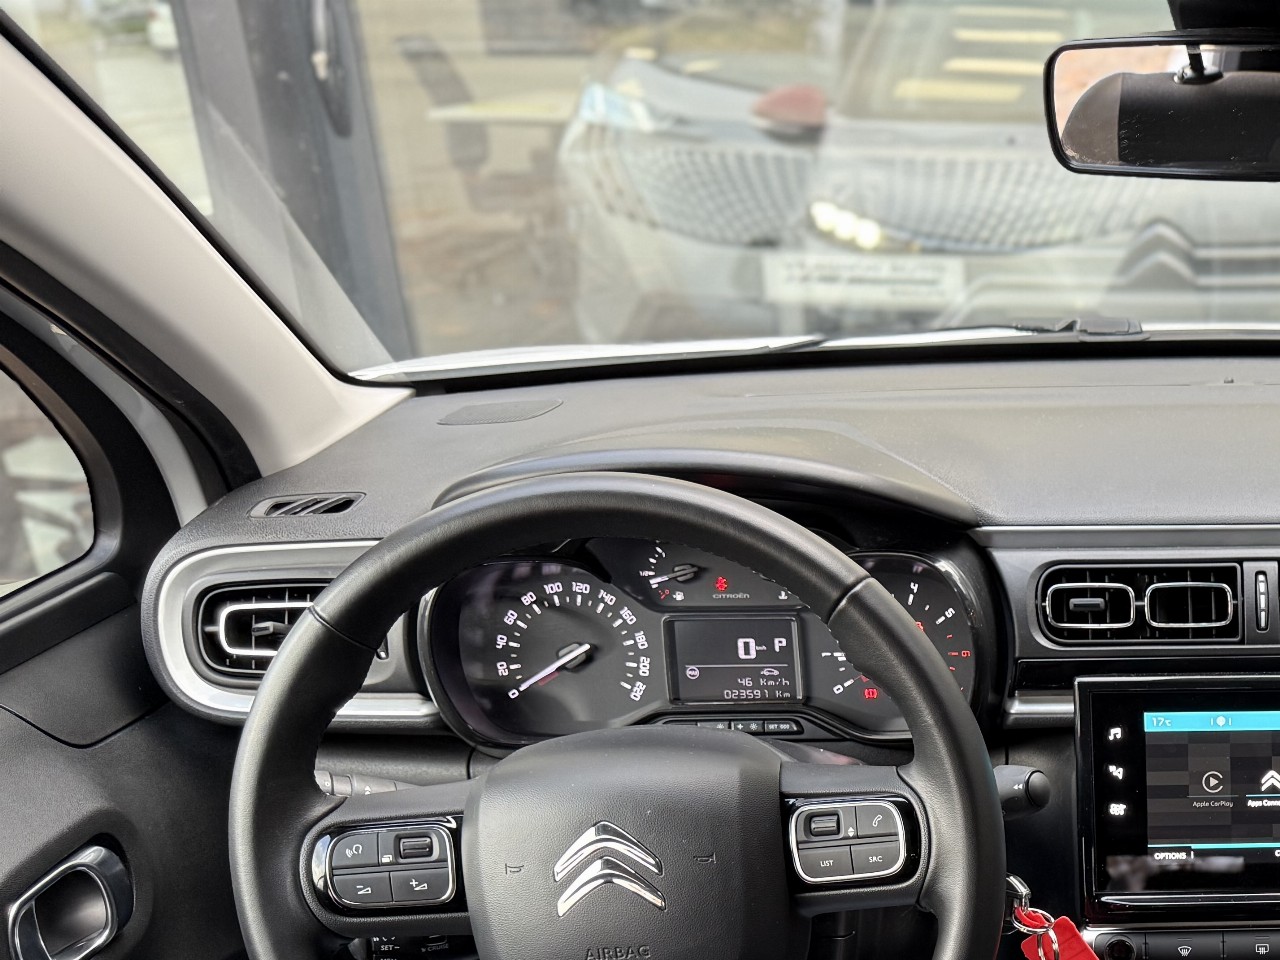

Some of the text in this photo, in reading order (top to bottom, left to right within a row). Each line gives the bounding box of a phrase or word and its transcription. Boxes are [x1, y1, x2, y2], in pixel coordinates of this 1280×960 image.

[543, 582, 563, 594] 100
[571, 581, 590, 594] 120
[910, 581, 919, 593] 4
[520, 591, 537, 606] 80
[598, 589, 616, 606] 140
[503, 609, 518, 626] 60
[619, 606, 637, 625] 160
[944, 607, 956, 618] 5
[496, 634, 507, 649] 40
[634, 630, 648, 650] 180
[774, 637, 787, 652] P
[737, 637, 757, 659] 0
[496, 661, 509, 676] 20
[639, 656, 650, 677] 200
[737, 677, 753, 687] 46
[833, 684, 844, 694] 0
[507, 688, 519, 699] 0
[629, 681, 647, 701] 220
[724, 690, 769, 699] 023591
[868, 855, 883, 863] SRC
[1154, 852, 1187, 860] OPTIONS
